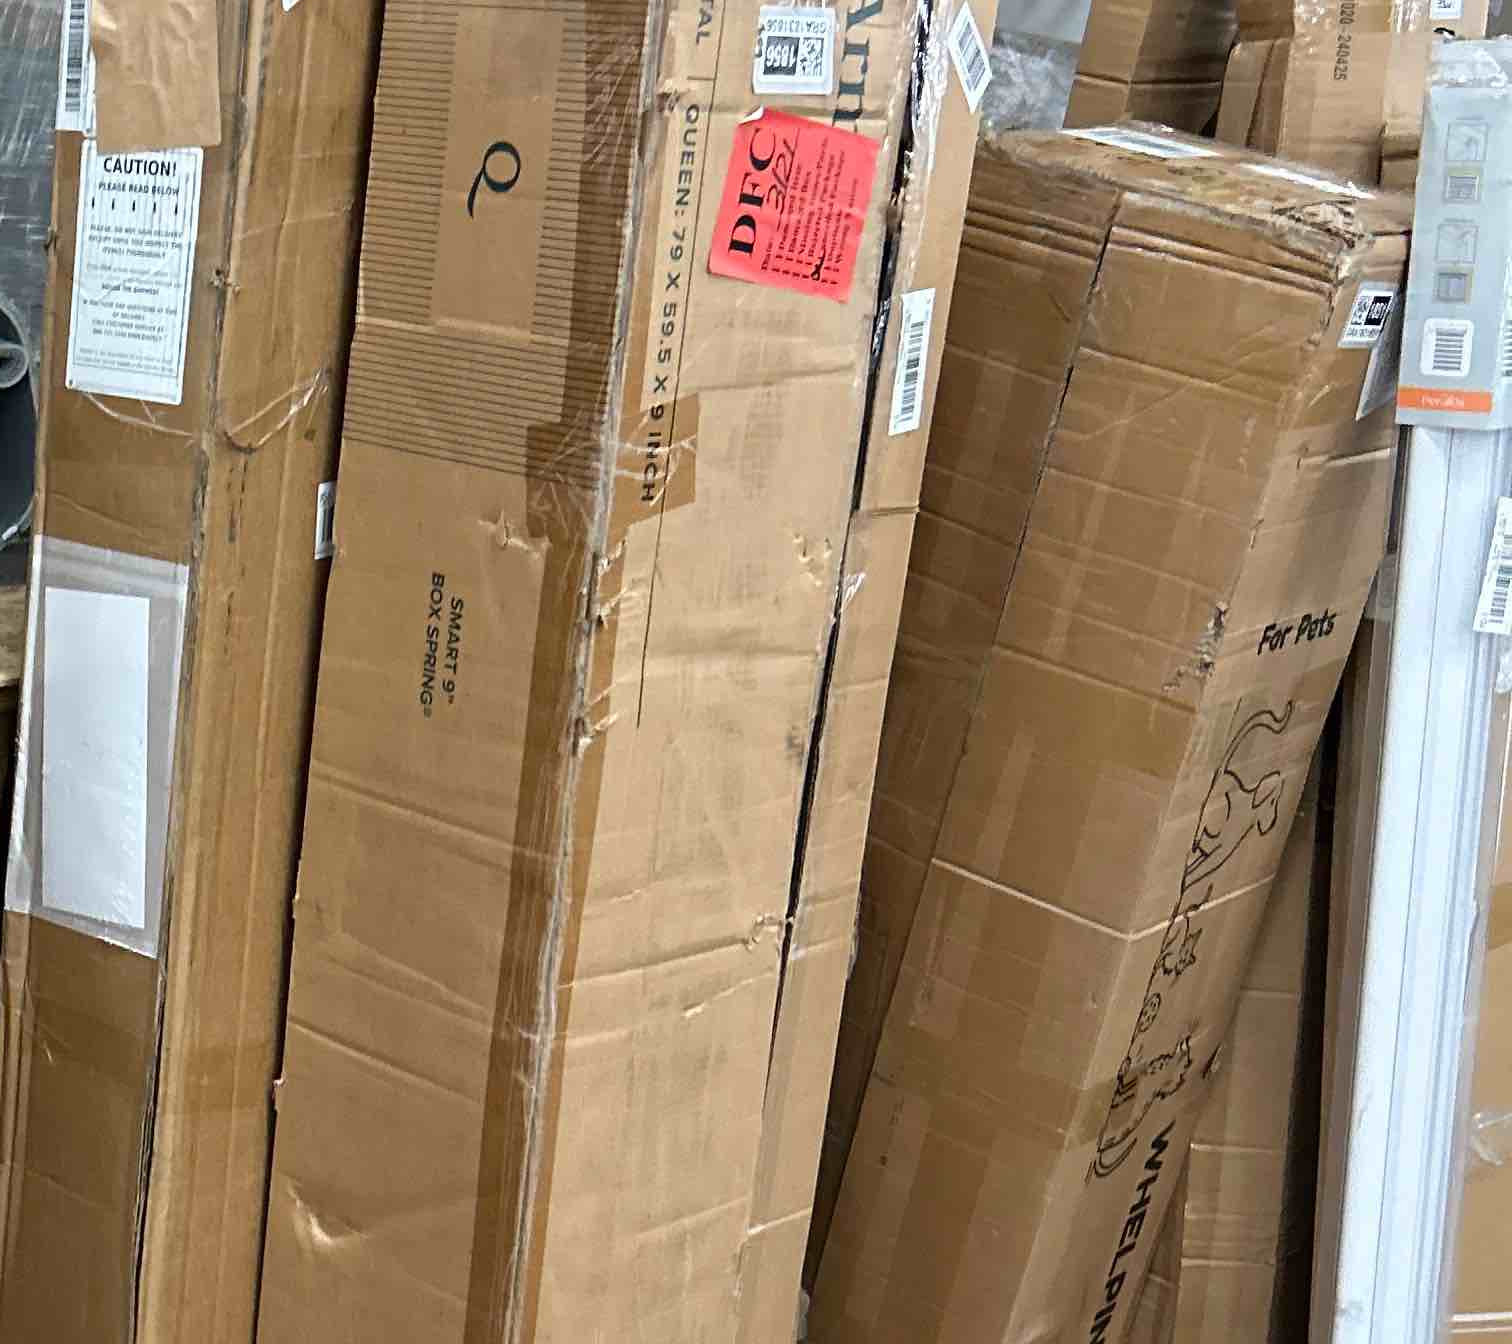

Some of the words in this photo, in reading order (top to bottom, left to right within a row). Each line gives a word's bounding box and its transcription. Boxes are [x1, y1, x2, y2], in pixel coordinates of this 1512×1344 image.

[766, 45, 796, 68] 1856
[103, 157, 177, 177] CAUTION!
[466, 141, 521, 219] Q
[674, 104, 700, 216] QUEEN:
[98, 182, 126, 193] PLEASE
[128, 184, 149, 194] READ
[726, 126, 779, 258] DFC
[670, 227, 686, 262] 79
[665, 271, 682, 293] X
[657, 301, 677, 364] 59.5
[653, 374, 669, 394] X
[650, 404, 664, 421] 9
[640, 432, 663, 504] INCH
[428, 571, 445, 621] BOX
[444, 596, 465, 675] SMART
[1257, 619, 1295, 655] For
[1294, 608, 1336, 642] Pets
